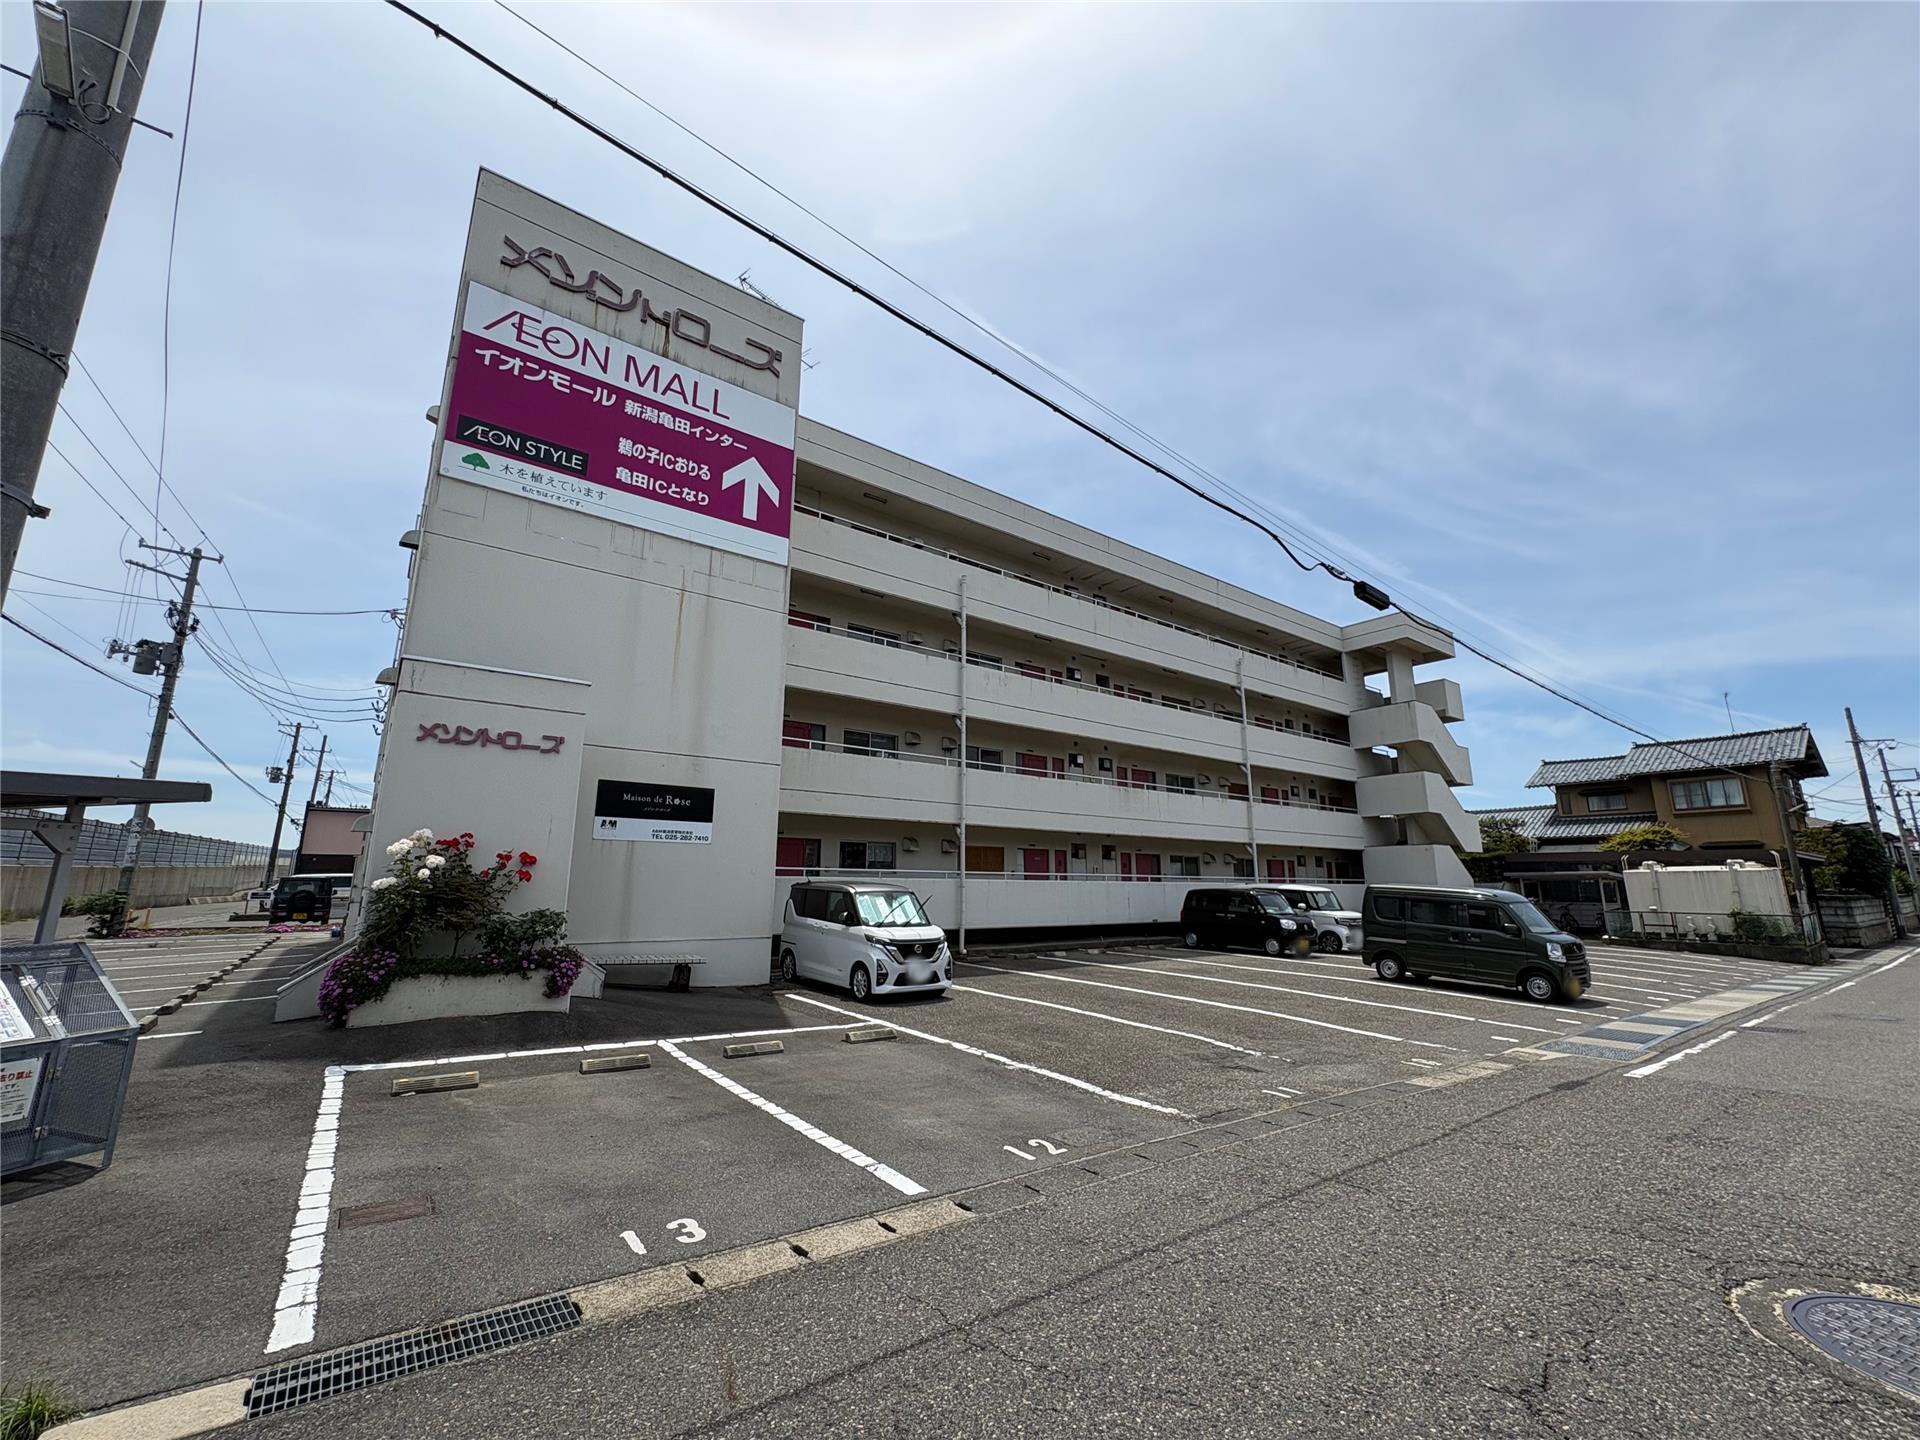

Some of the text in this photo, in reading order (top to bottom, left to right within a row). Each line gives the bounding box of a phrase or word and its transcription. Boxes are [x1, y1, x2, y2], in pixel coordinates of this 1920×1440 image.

[474, 347, 748, 451] イオンモール 新潟亀田インター
[624, 353, 731, 421] MALL
[524, 441, 583, 470] STYLE
[617, 436, 711, 481] 鵜の子ICおりる
[499, 462, 608, 501] 木を植えています
[521, 486, 585, 508] 私たちはイオンです。
[615, 466, 710, 506] 亀田ICとなり
[622, 793, 652, 803] Maison
[653, 795, 664, 803] de
[665, 834, 709, 842] 025-282-7410
[1003, 1137, 1069, 1162] 12
[618, 1217, 708, 1255] 13
